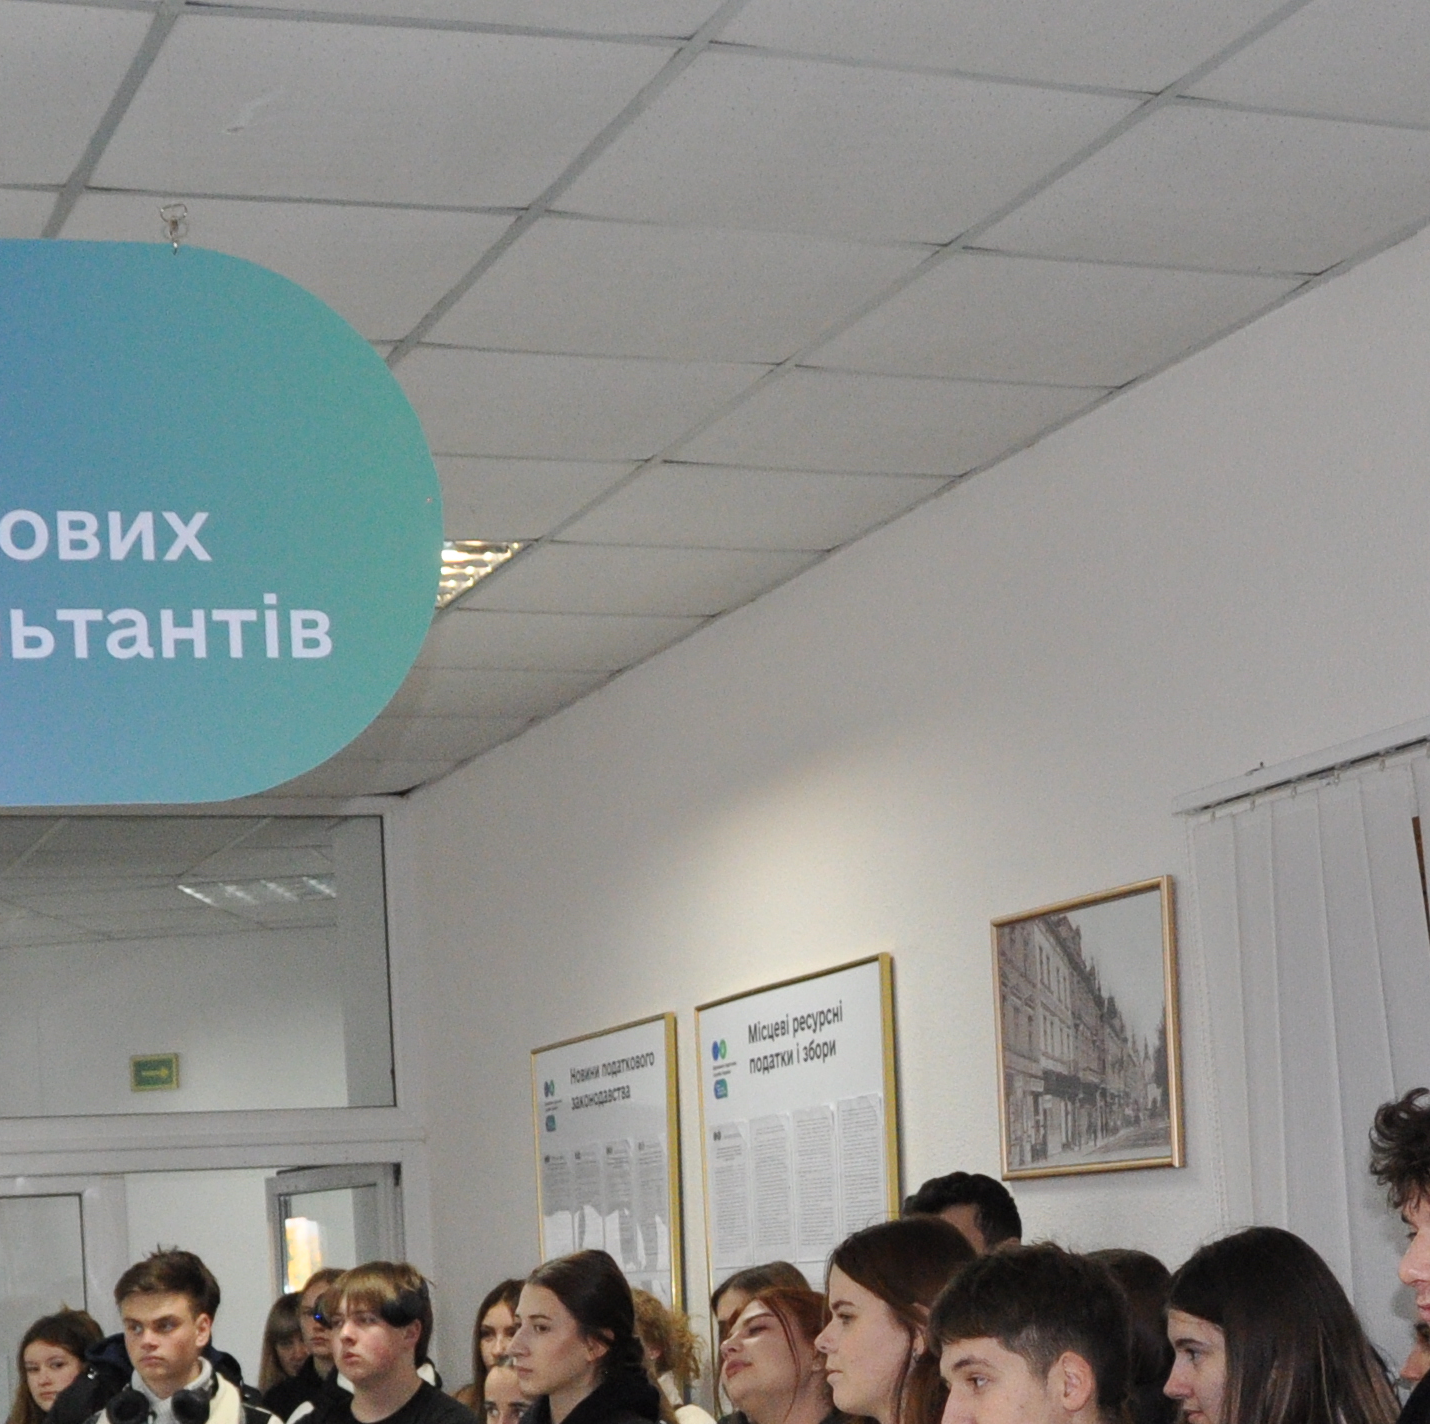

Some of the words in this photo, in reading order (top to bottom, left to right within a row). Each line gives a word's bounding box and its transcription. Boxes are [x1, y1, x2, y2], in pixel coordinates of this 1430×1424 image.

[748, 1013, 790, 1044] Місцеві
[792, 999, 843, 1039] ресурсні
[570, 1065, 600, 1085] Новини
[601, 1051, 655, 1078] податкового
[749, 1048, 794, 1075] податки
[802, 1039, 837, 1064] збори
[571, 1084, 631, 1111] законодавства
